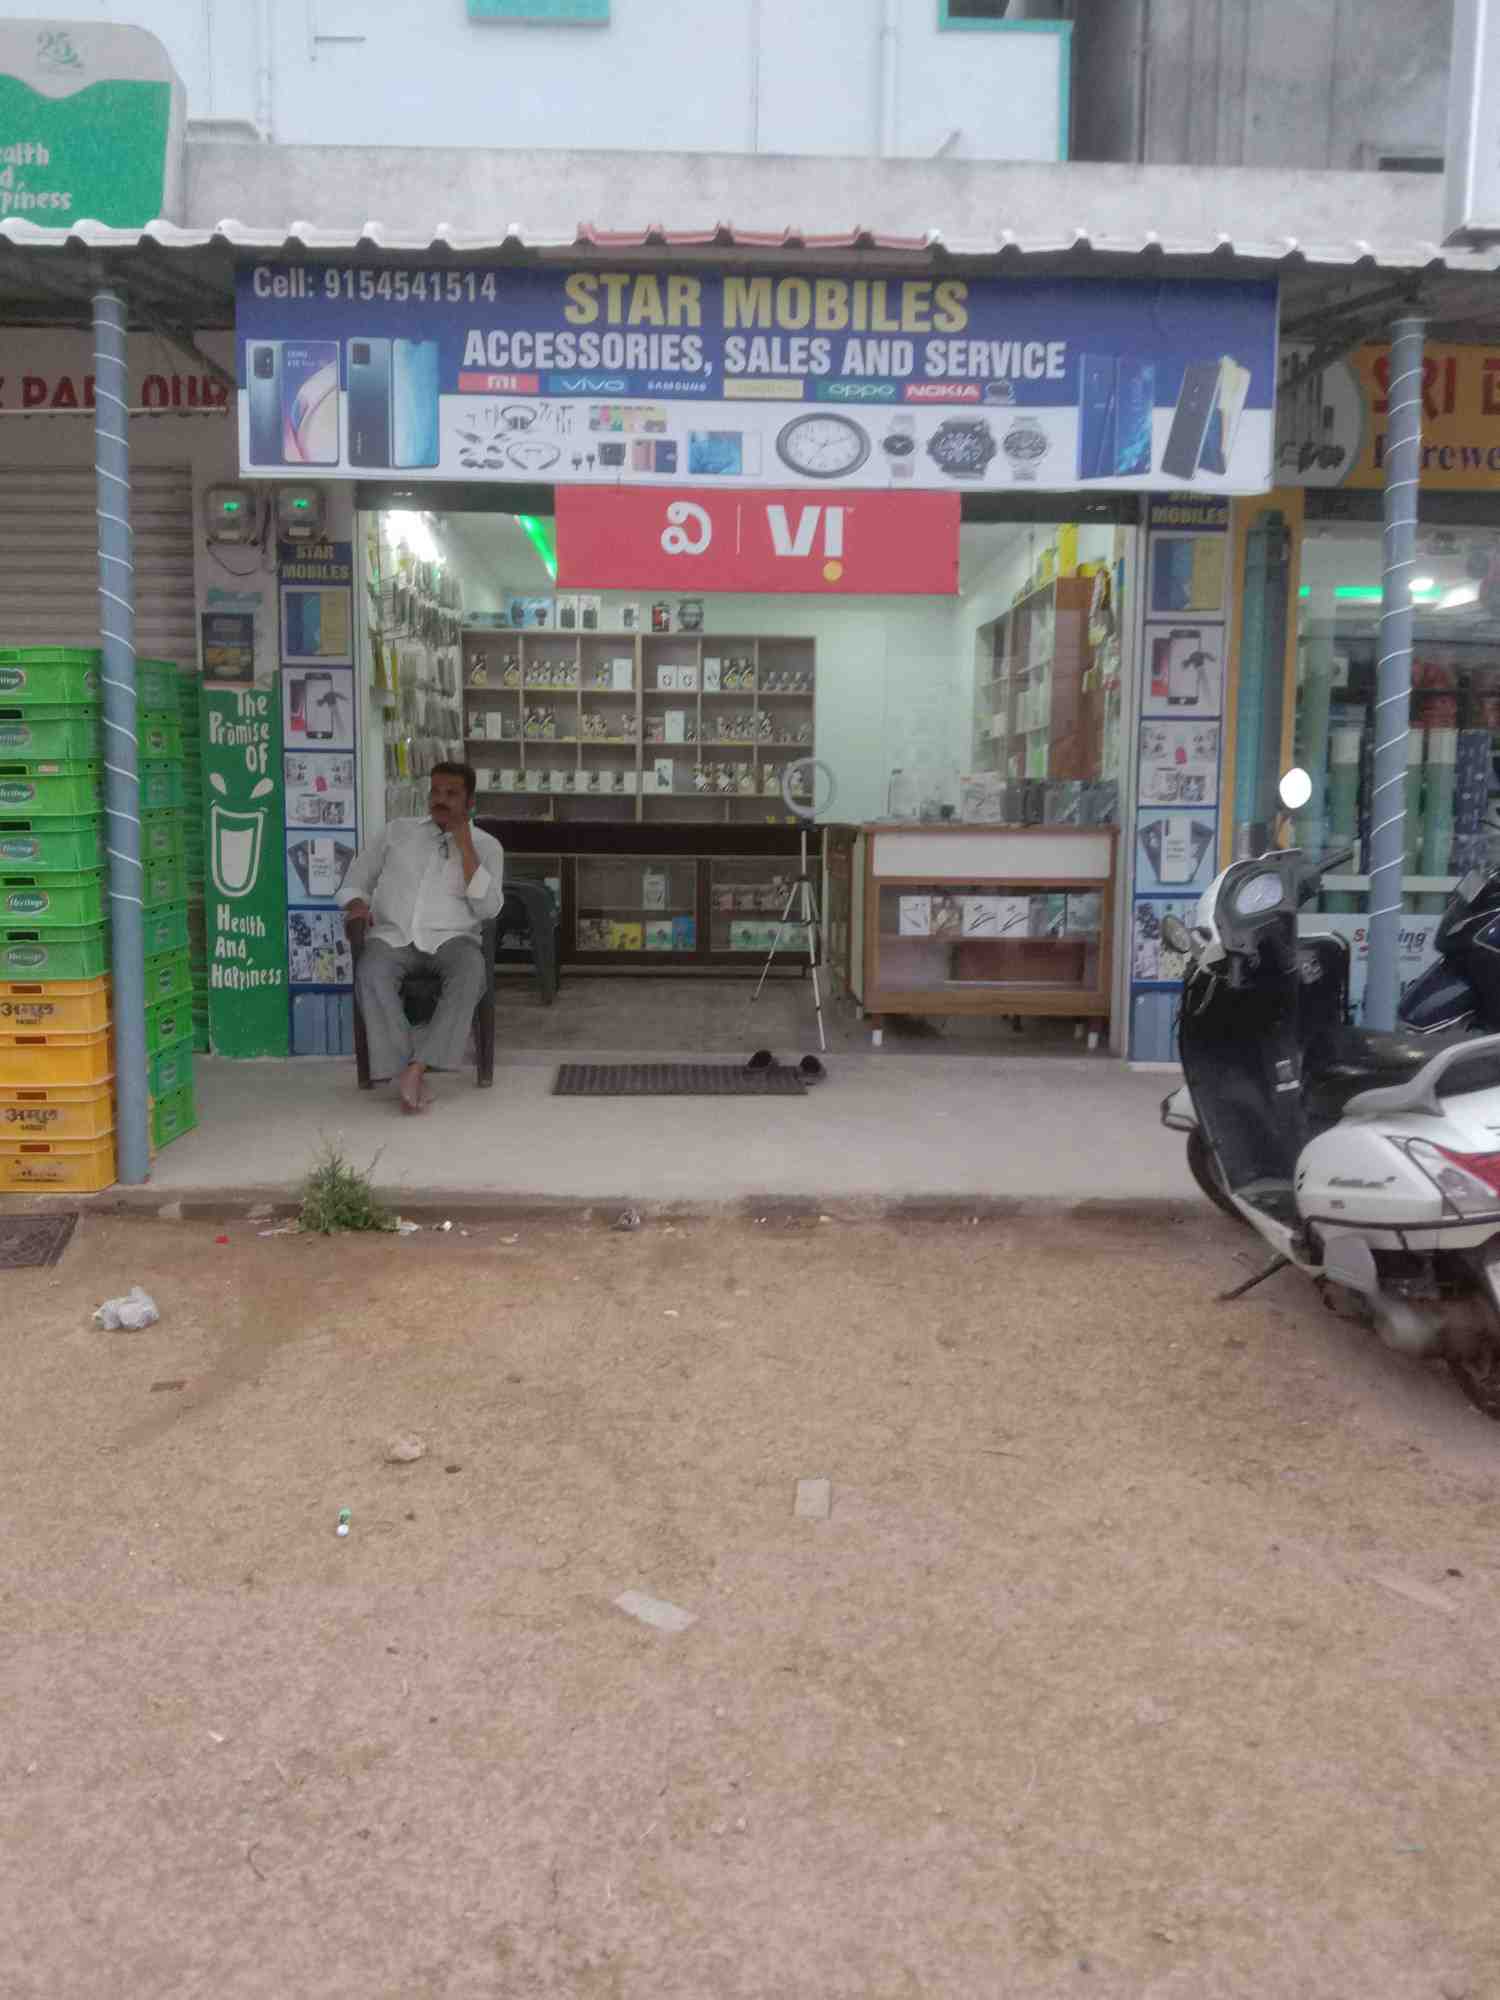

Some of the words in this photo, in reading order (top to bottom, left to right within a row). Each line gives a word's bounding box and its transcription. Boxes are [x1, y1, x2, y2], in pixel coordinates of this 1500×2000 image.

[253, 266, 314, 299] Cell:
[324, 268, 497, 304] 9154541514
[563, 273, 702, 325] STAR
[722, 276, 969, 334] MOBILES
[462, 329, 714, 376] ACCESSORIES,
[724, 337, 831, 375] SALES
[841, 338, 914, 377] AND
[924, 340, 1066, 380] SERVICE
[905, 383, 980, 398] NOKIA
[236, 690, 268, 718] The
[217, 903, 266, 937] Health
[211, 958, 282, 991] Happiness
